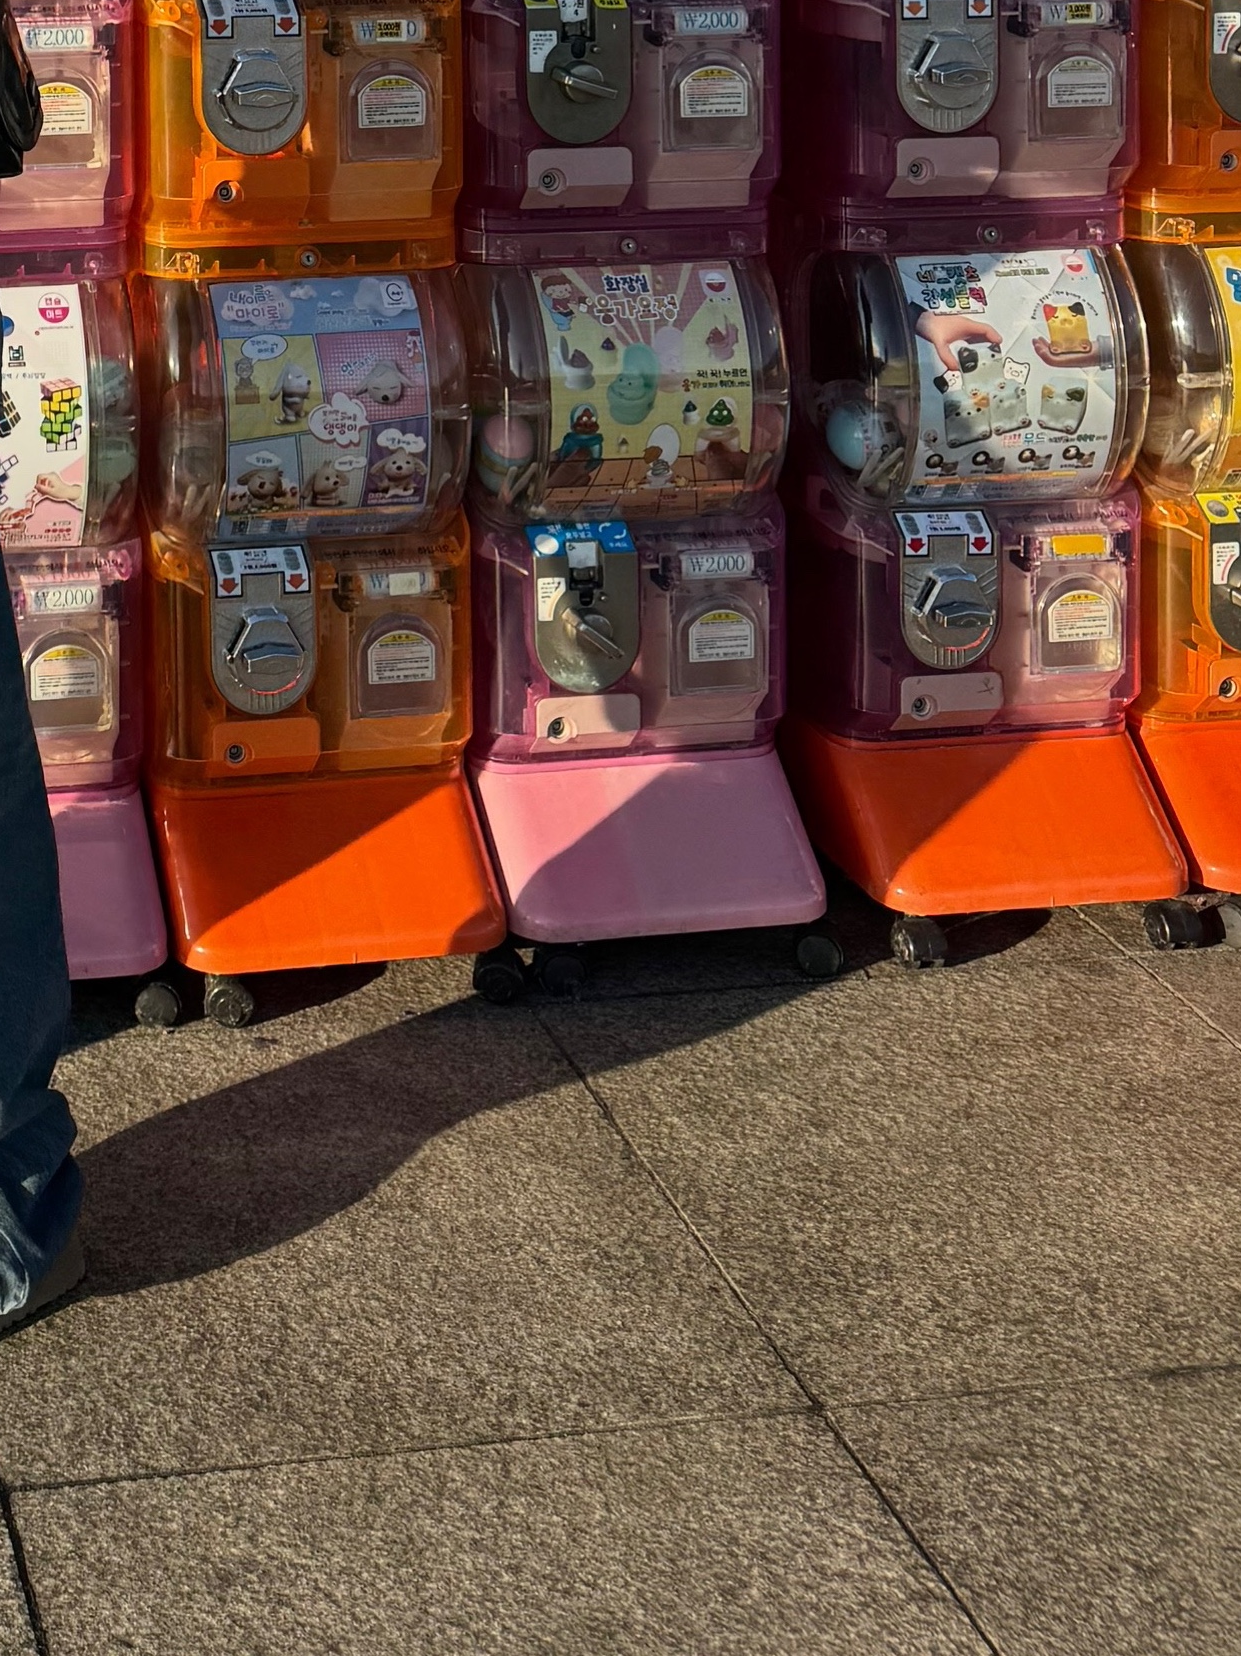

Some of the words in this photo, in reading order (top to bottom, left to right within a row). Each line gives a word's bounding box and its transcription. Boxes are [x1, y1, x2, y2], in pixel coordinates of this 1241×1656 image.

[683, 11, 740, 30] ₩2,000
[603, 273, 651, 293] 화장실
[323, 422, 358, 436] 댕댕이
[689, 554, 746, 573] ₩2,000
[35, 588, 94, 608] ₩2,000
